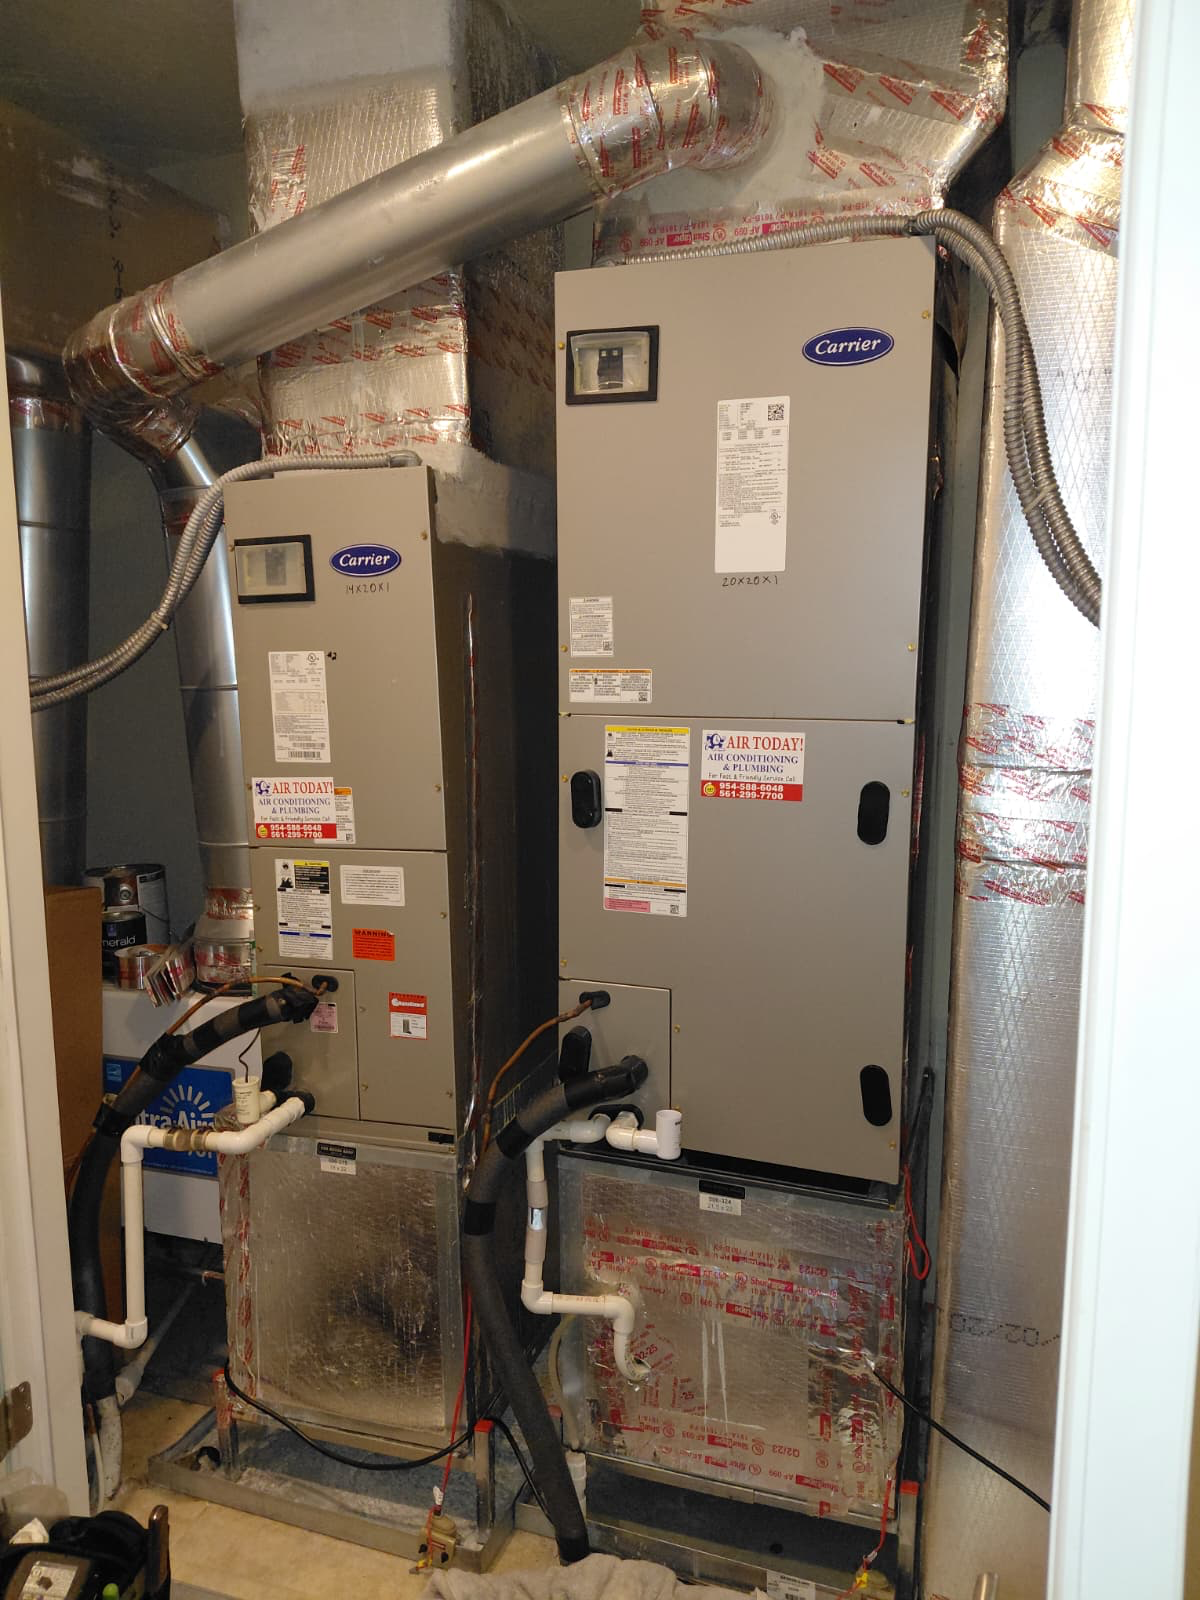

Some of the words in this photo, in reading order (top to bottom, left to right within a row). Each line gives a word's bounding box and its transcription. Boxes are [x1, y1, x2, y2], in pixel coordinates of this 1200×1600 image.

[815, 337, 881, 355] Carrier
[340, 553, 390, 567] Carrier
[727, 735, 750, 749] AIR
[752, 736, 803, 751] TODAY!
[708, 753, 724, 761] AIR
[726, 753, 798, 764] CONDITIONING
[723, 763, 730, 771] &
[733, 763, 784, 773] PLUMBING
[272, 782, 291, 794] AIR
[293, 782, 333, 794] TODAY!
[719, 782, 784, 792] 954-588-6048
[719, 790, 784, 799] 561-299-7700
[260, 798, 271, 806] AIR
[273, 798, 330, 806] CONDITIONING
